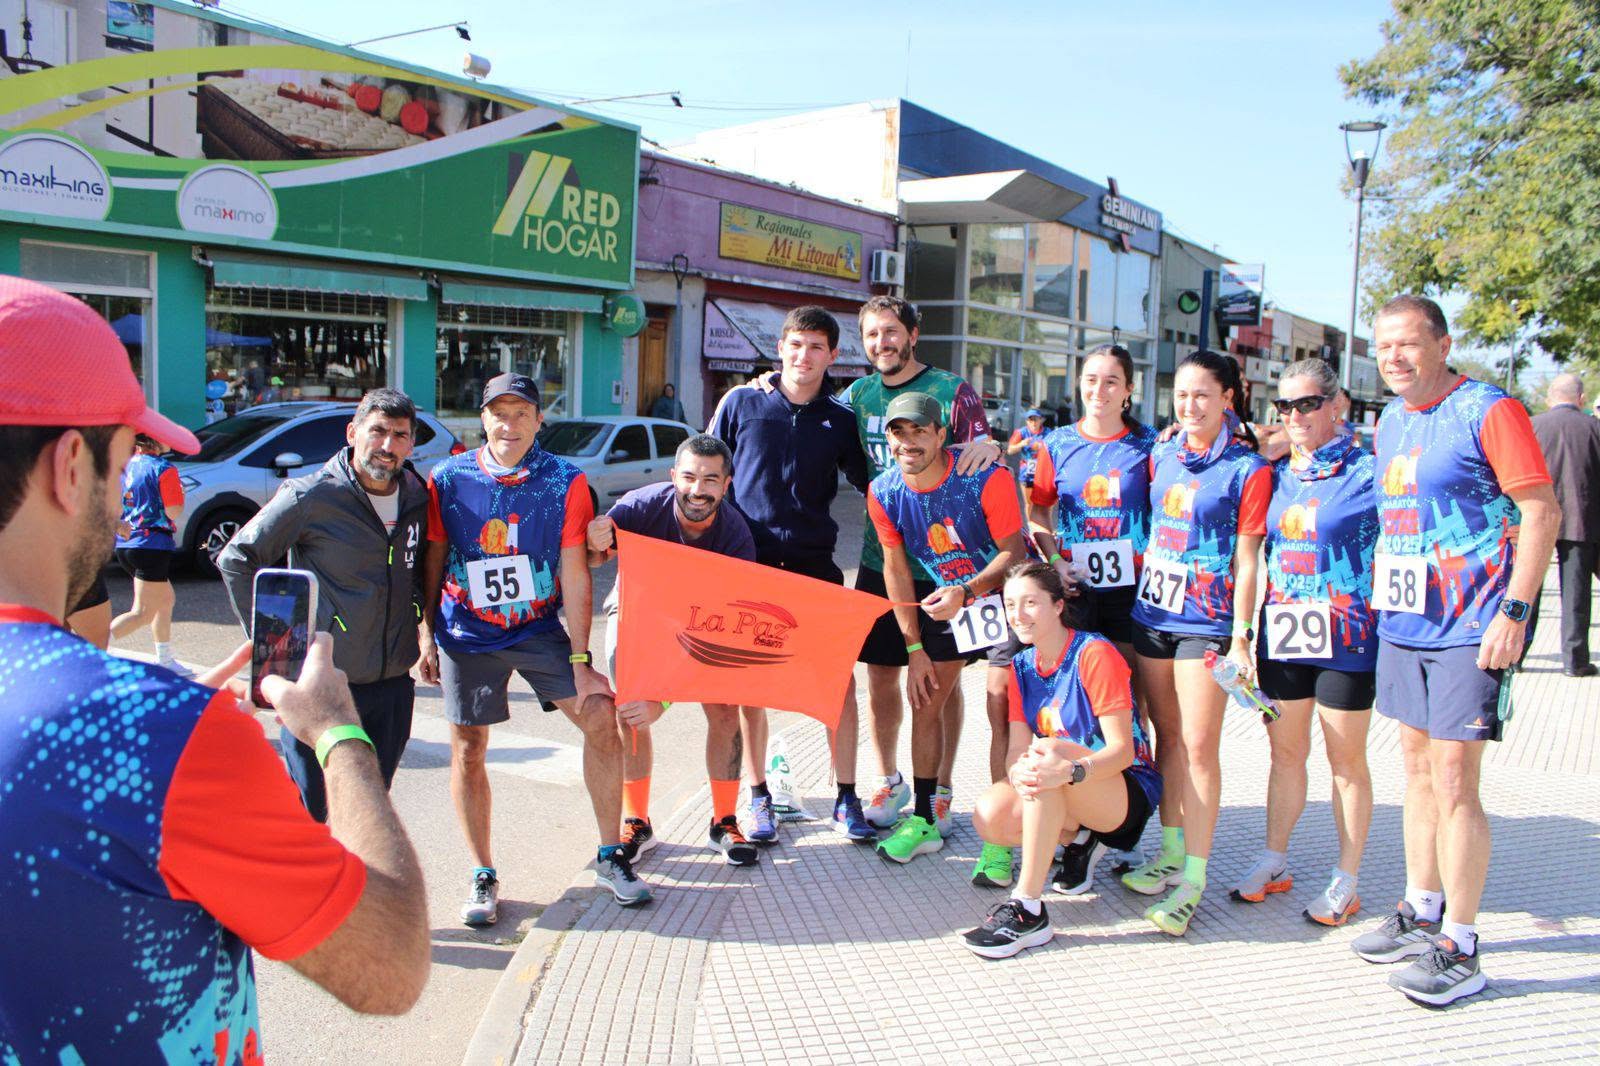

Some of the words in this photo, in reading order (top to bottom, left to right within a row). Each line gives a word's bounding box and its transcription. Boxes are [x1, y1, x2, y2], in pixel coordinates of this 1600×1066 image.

[194, 204, 264, 224] maximo
[562, 184, 620, 228] RED
[1103, 194, 1158, 230] GEMINIANI
[523, 215, 618, 263] HOGAR
[756, 214, 812, 239] Regionales
[767, 235, 793, 260] Mi
[796, 240, 842, 268] Litoral
[484, 566, 520, 602] 55
[1088, 550, 1122, 585] 93
[1279, 574, 1317, 592] 2025
[1141, 566, 1183, 608] 237
[1388, 569, 1417, 608] 58
[686, 606, 725, 632] La
[732, 611, 786, 640] Paz
[958, 604, 1003, 646] 18
[1273, 610, 1327, 655] 29
